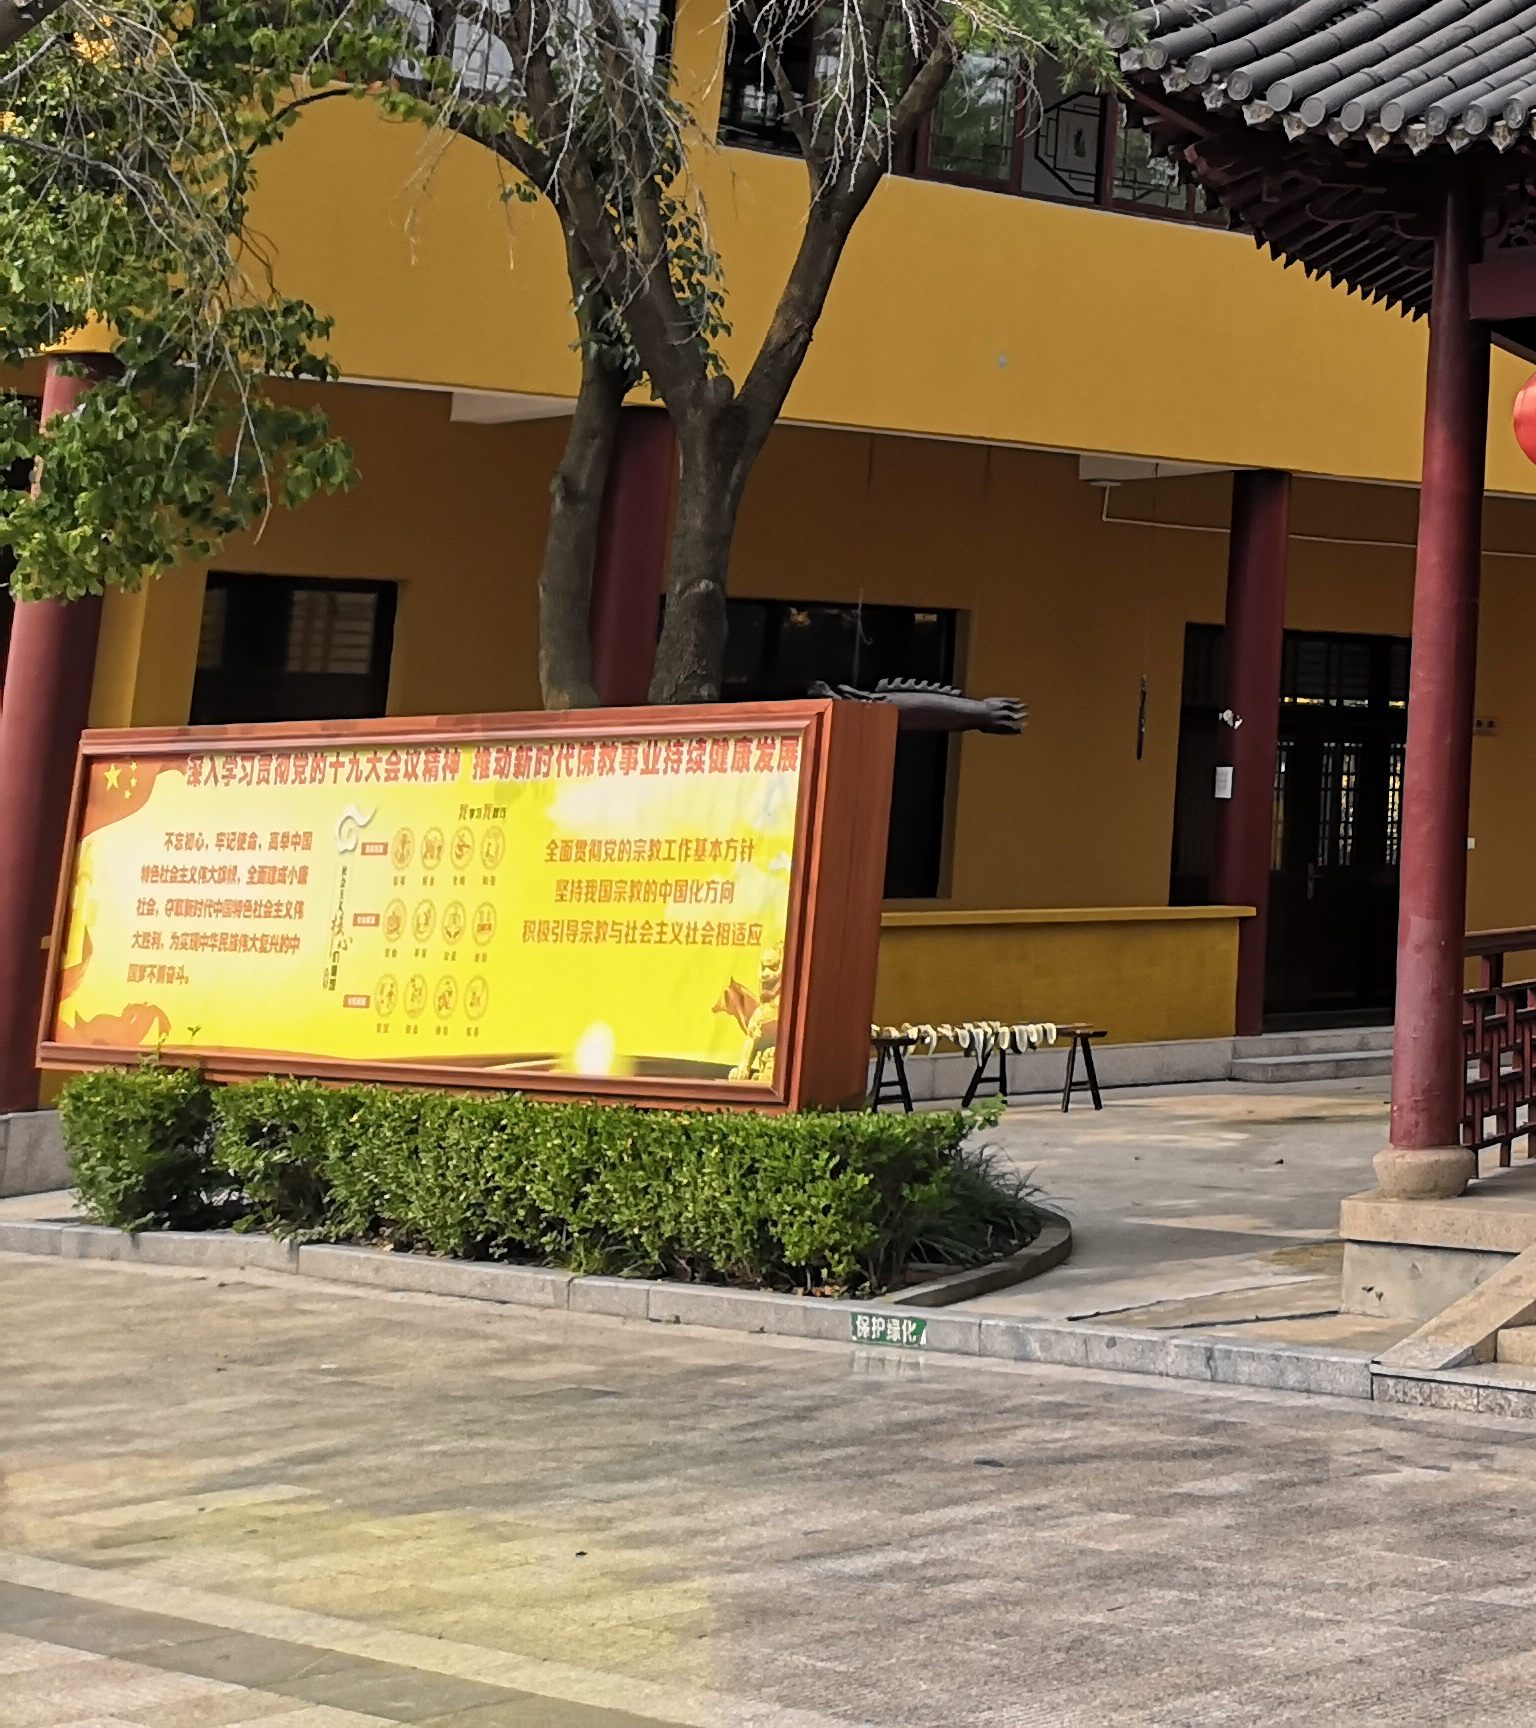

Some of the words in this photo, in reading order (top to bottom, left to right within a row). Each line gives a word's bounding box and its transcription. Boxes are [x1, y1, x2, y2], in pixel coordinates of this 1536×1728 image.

[544, 838, 755, 863] 全面贯彻党的宗教工作基本方针
[554, 878, 735, 905] 坚持我国宗教的中国化方向
[521, 919, 763, 947] 积极引导宗教与社会主义社会相适应
[856, 1314, 916, 1343] 保护绿化
